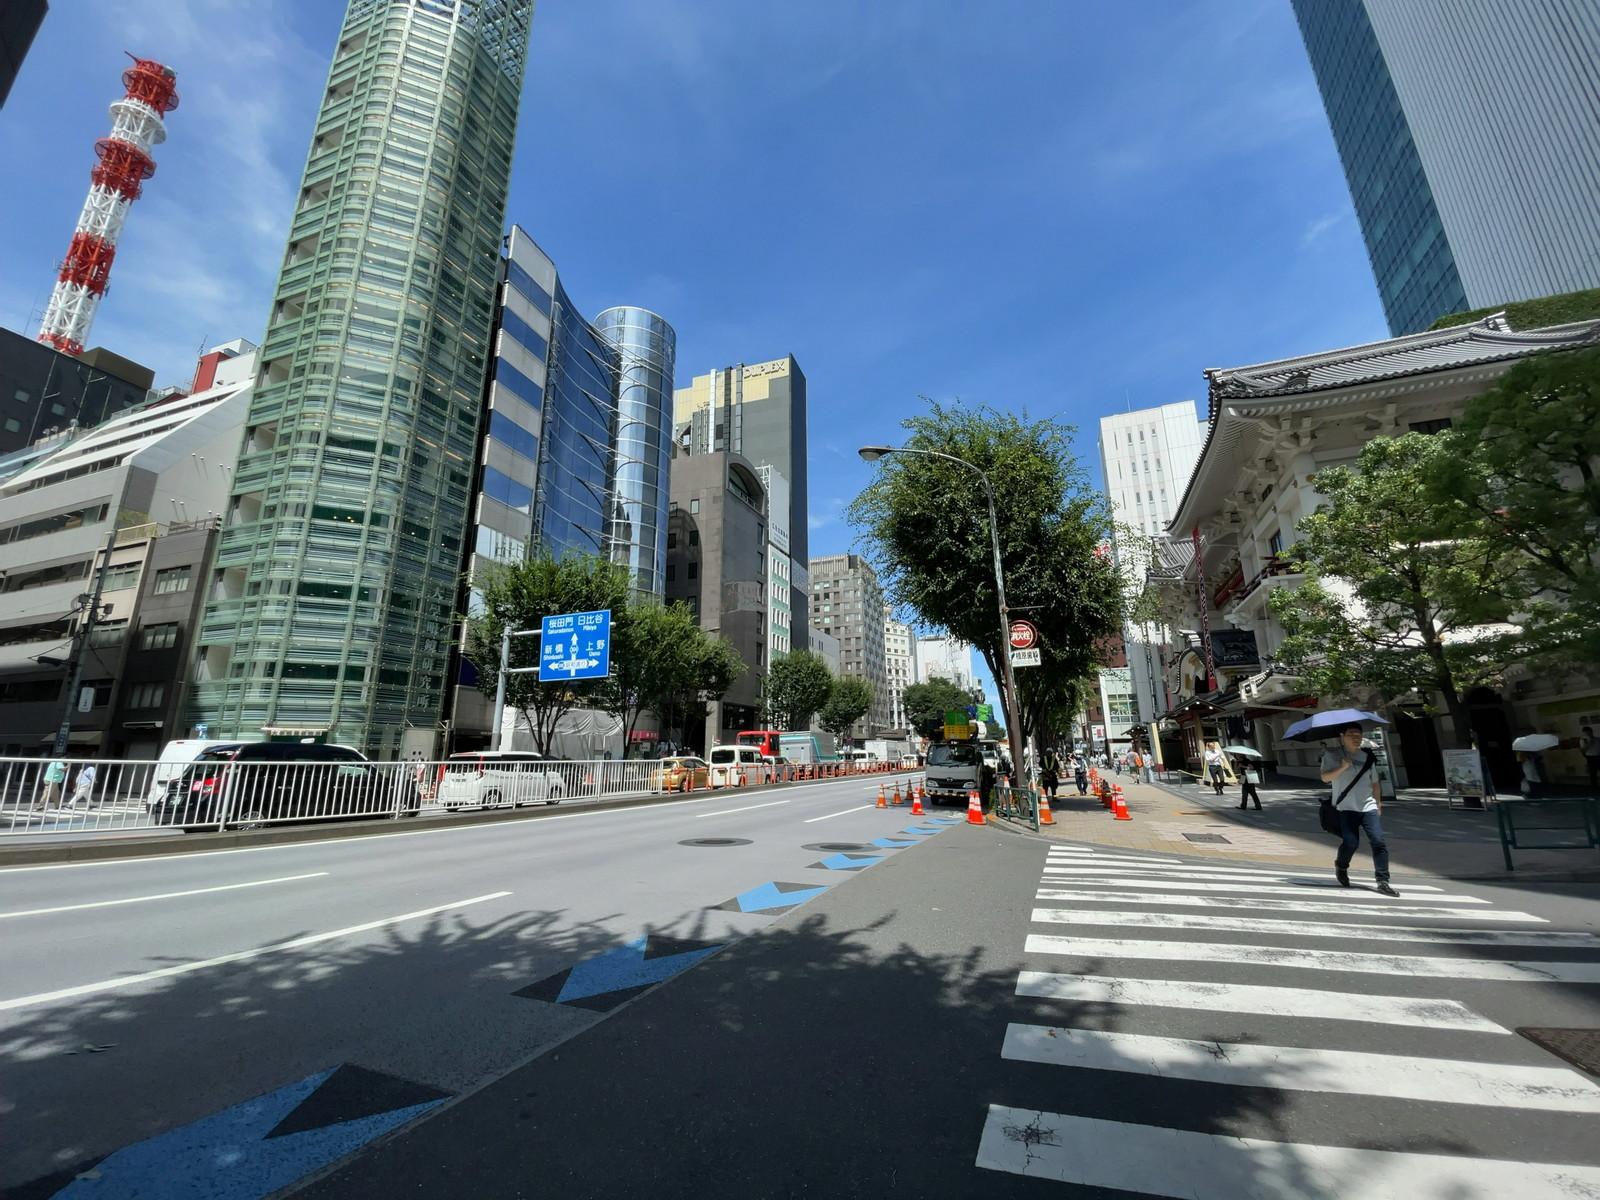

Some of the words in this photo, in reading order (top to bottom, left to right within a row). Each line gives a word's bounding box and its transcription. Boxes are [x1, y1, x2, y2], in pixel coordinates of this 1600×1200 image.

[548, 616, 573, 628] 桜田門
[578, 614, 603, 625] 日比谷
